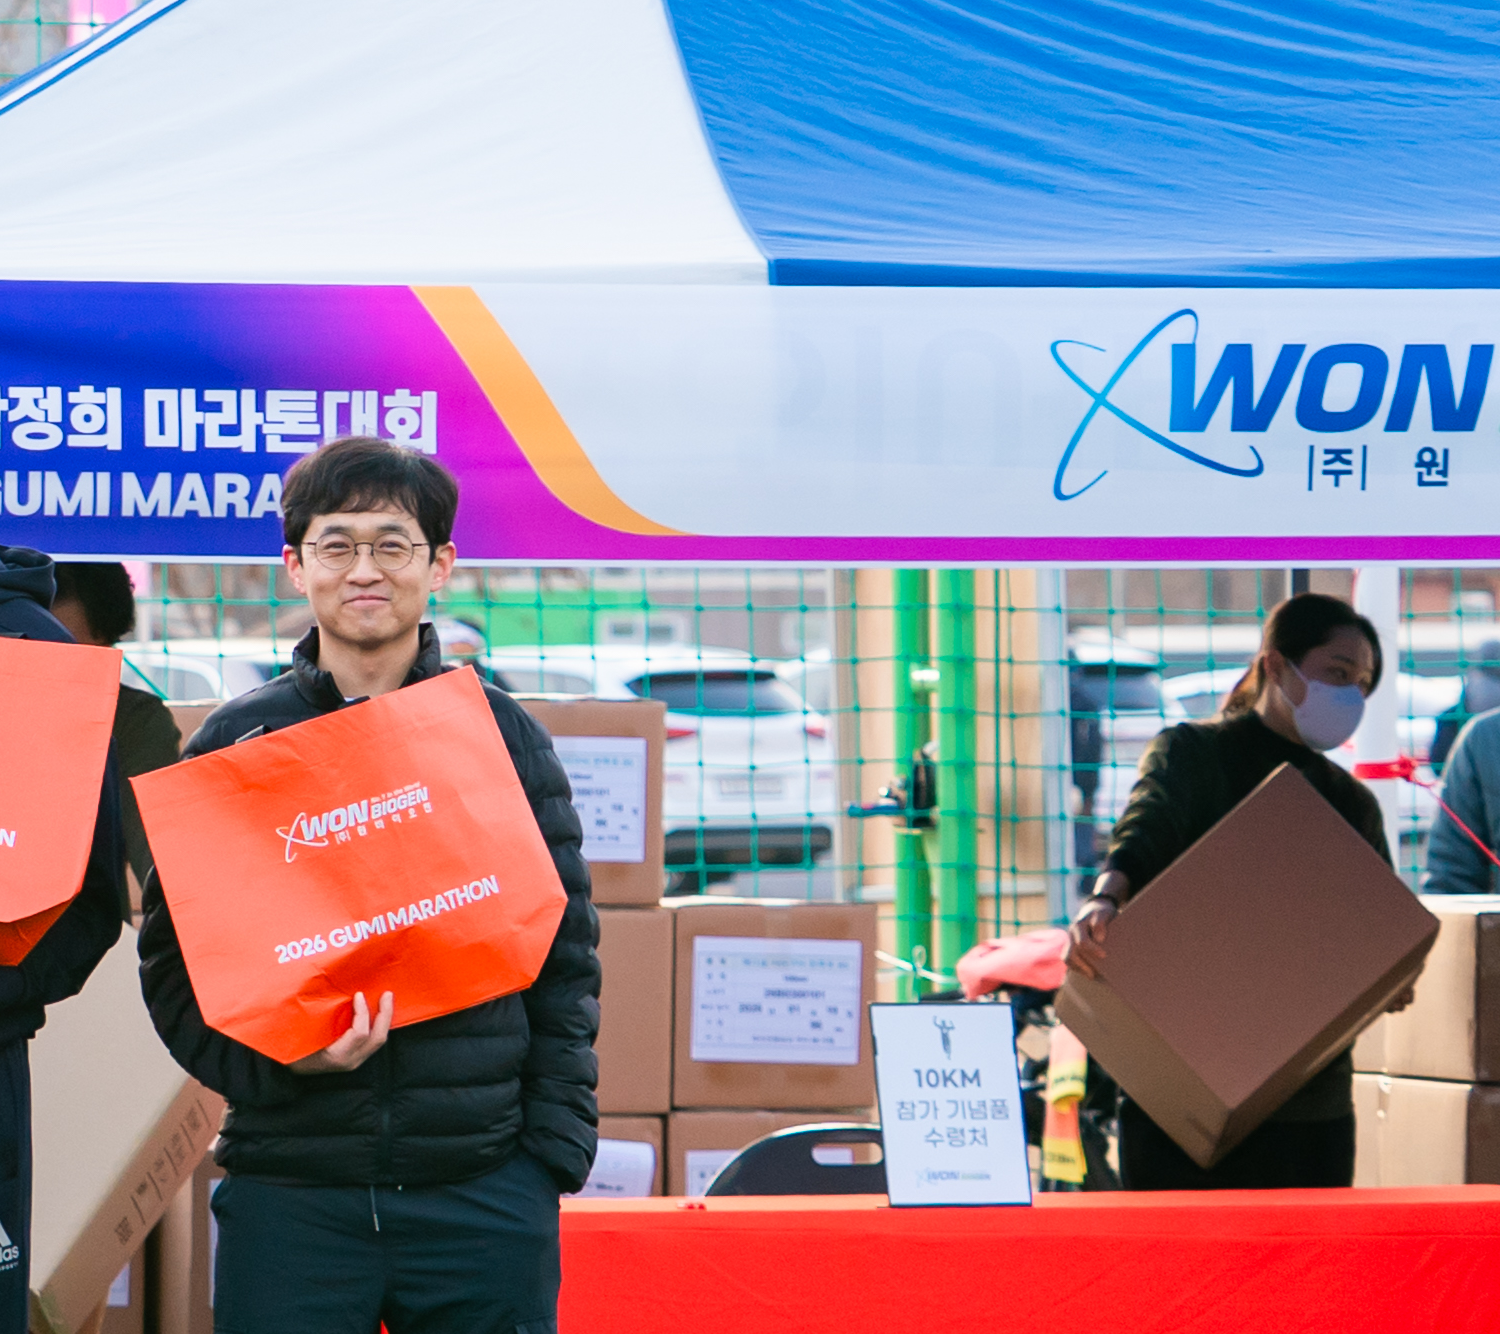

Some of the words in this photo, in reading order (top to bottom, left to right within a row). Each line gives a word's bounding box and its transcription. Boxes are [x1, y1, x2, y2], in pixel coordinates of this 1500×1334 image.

[1169, 344, 1495, 433] WON
[144, 388, 438, 455] 마라톤대회
[121, 473, 284, 520] MARA
[301, 799, 369, 841] WON
[371, 787, 429, 818] BIOGEN
[274, 934, 328, 964] 2026
[329, 914, 386, 948] GUMI
[387, 874, 501, 930] MARATHON
[913, 1067, 982, 1089] 10KM
[895, 1100, 940, 1121] 참가
[947, 1098, 1010, 1121] 기념품
[924, 1126, 988, 1148] 수령처
